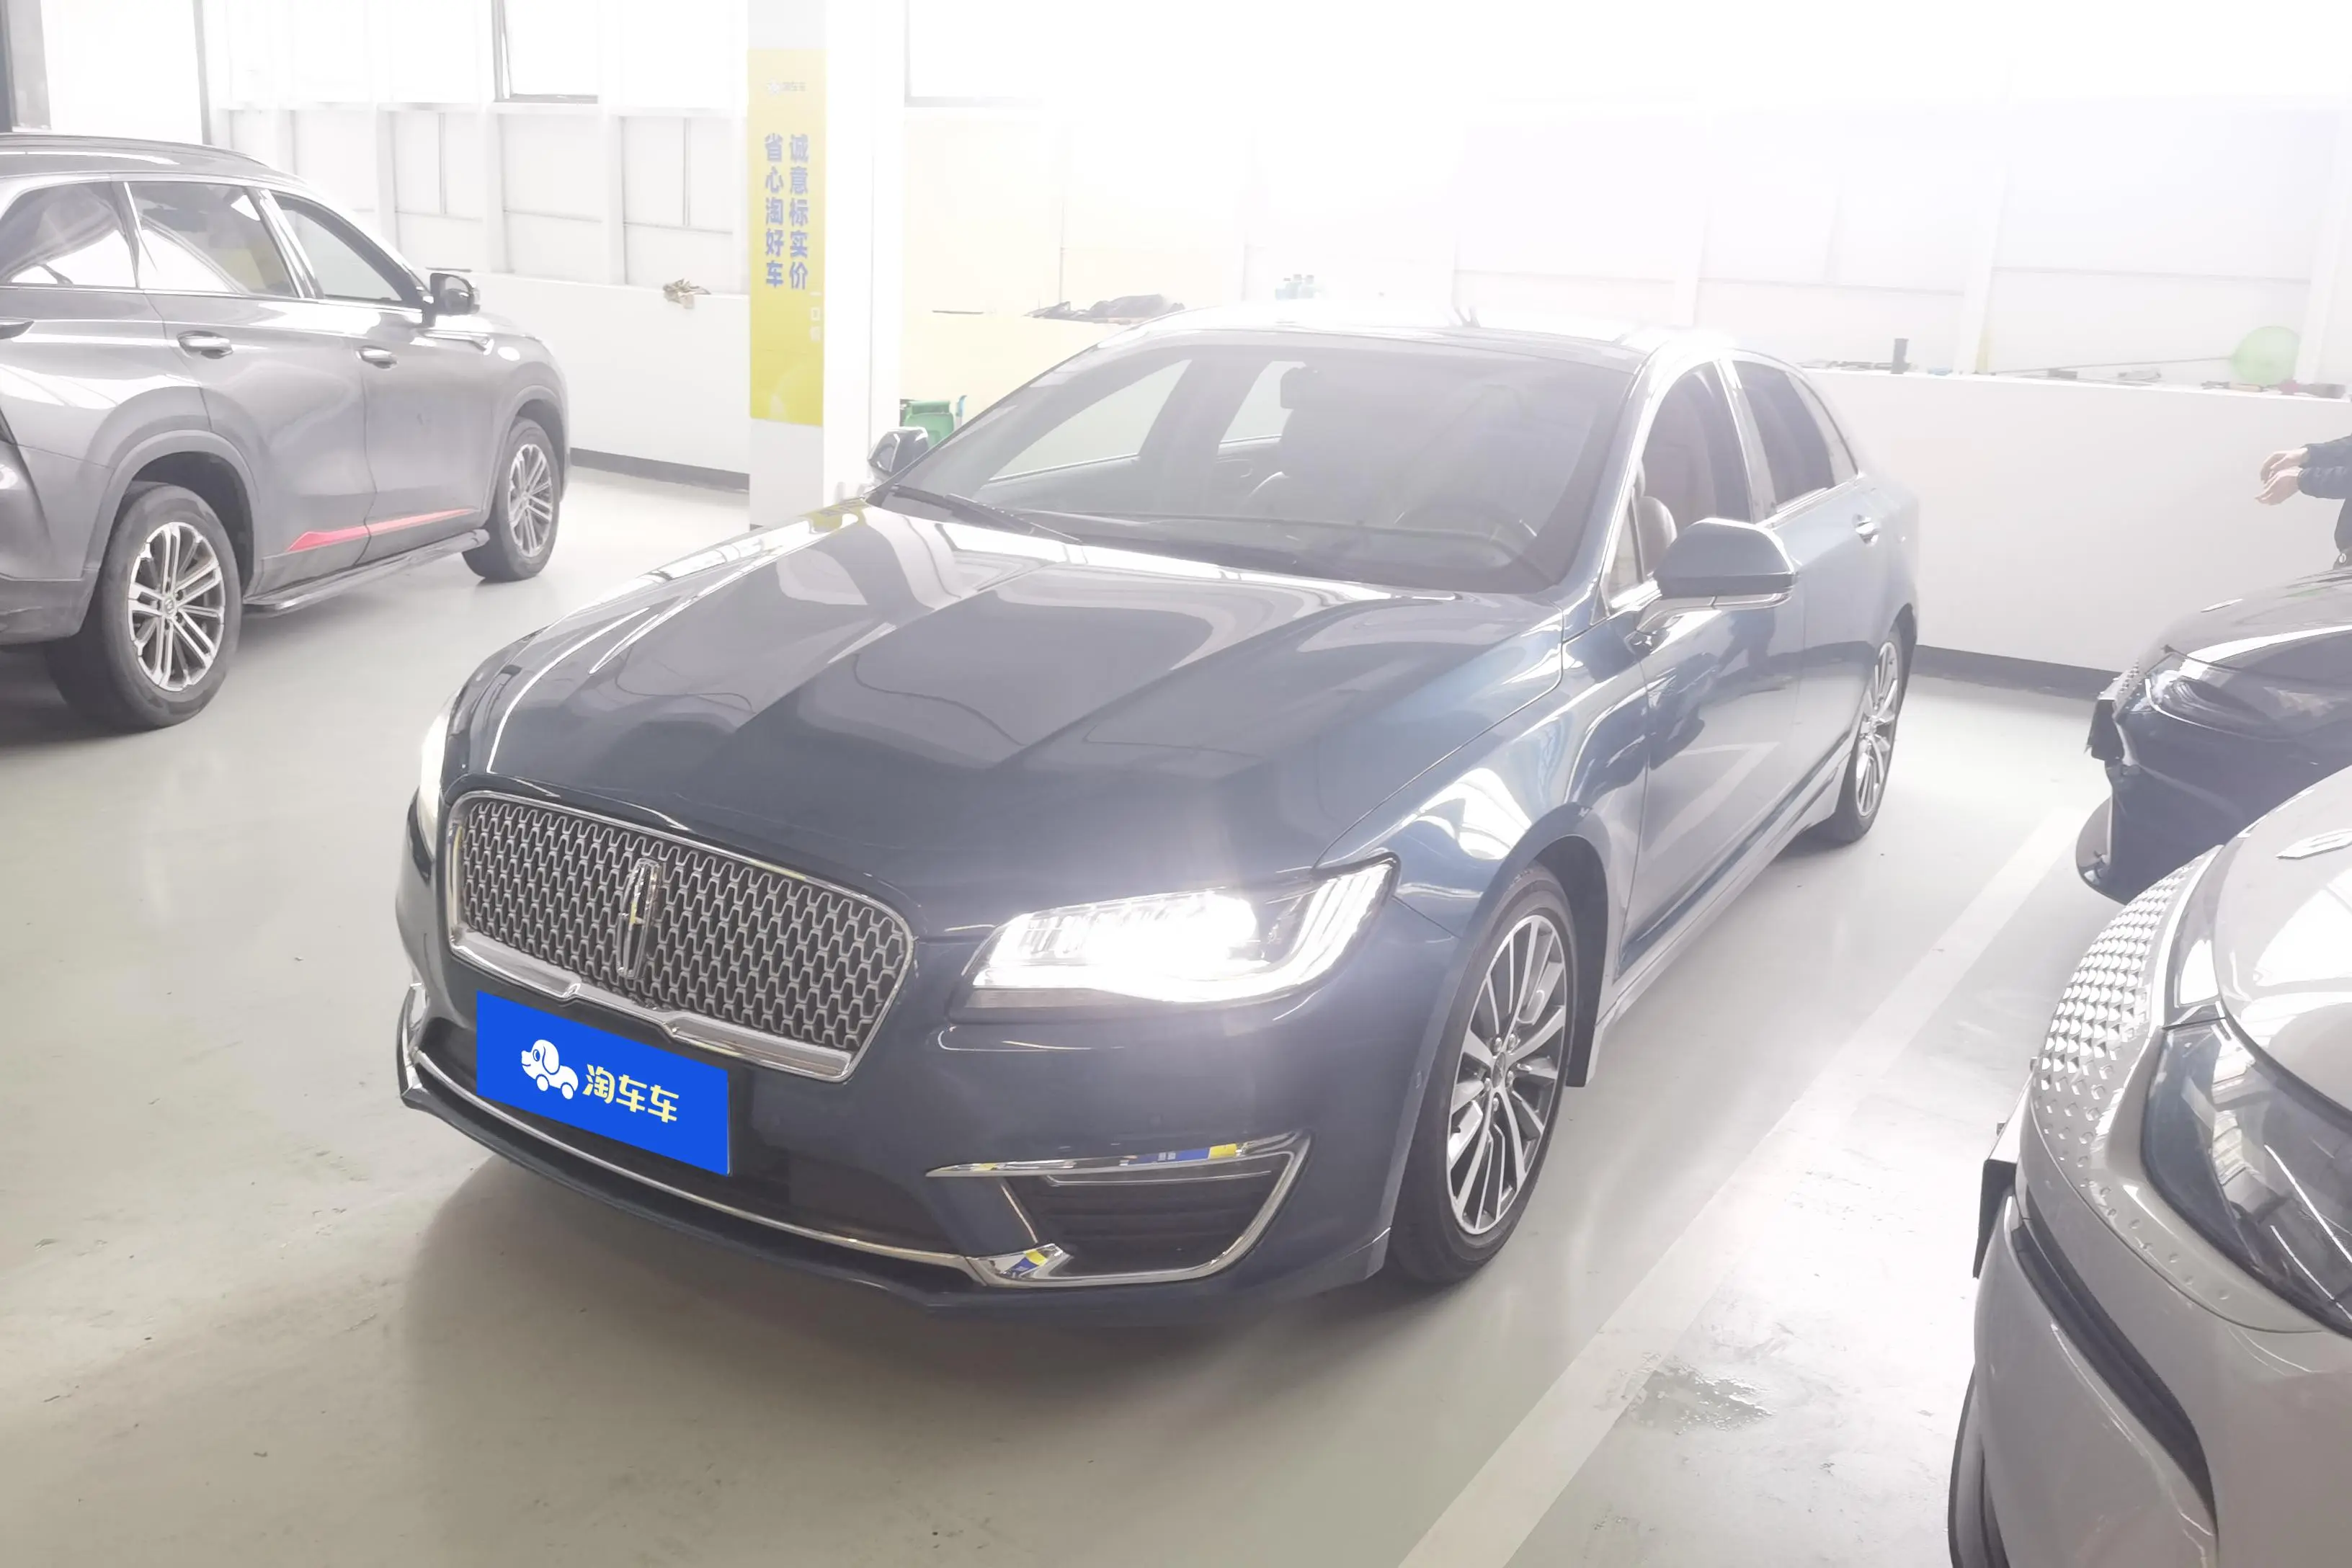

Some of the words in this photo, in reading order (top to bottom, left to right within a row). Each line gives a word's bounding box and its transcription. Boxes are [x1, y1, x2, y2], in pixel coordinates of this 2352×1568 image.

[765, 133, 784, 288] 省心淘好车
[789, 134, 808, 290] 诚意标实价
